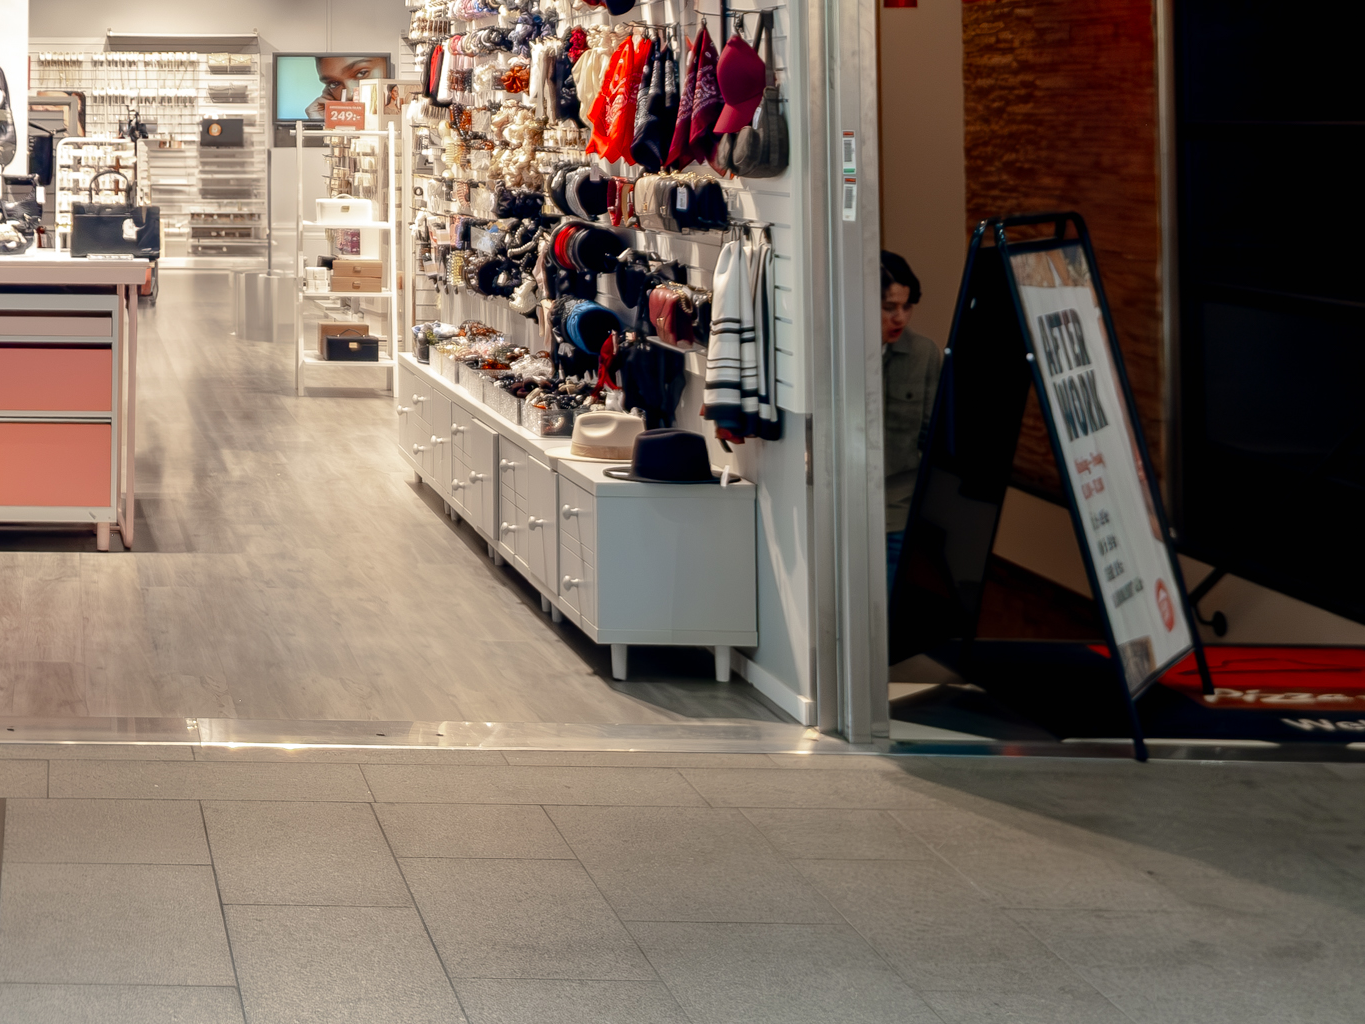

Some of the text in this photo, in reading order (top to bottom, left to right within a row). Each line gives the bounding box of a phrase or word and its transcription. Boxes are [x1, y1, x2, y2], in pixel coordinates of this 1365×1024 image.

[330, 110, 361, 121] 249:-
[1037, 308, 1091, 377] AFTER
[1053, 368, 1109, 442] WORK
